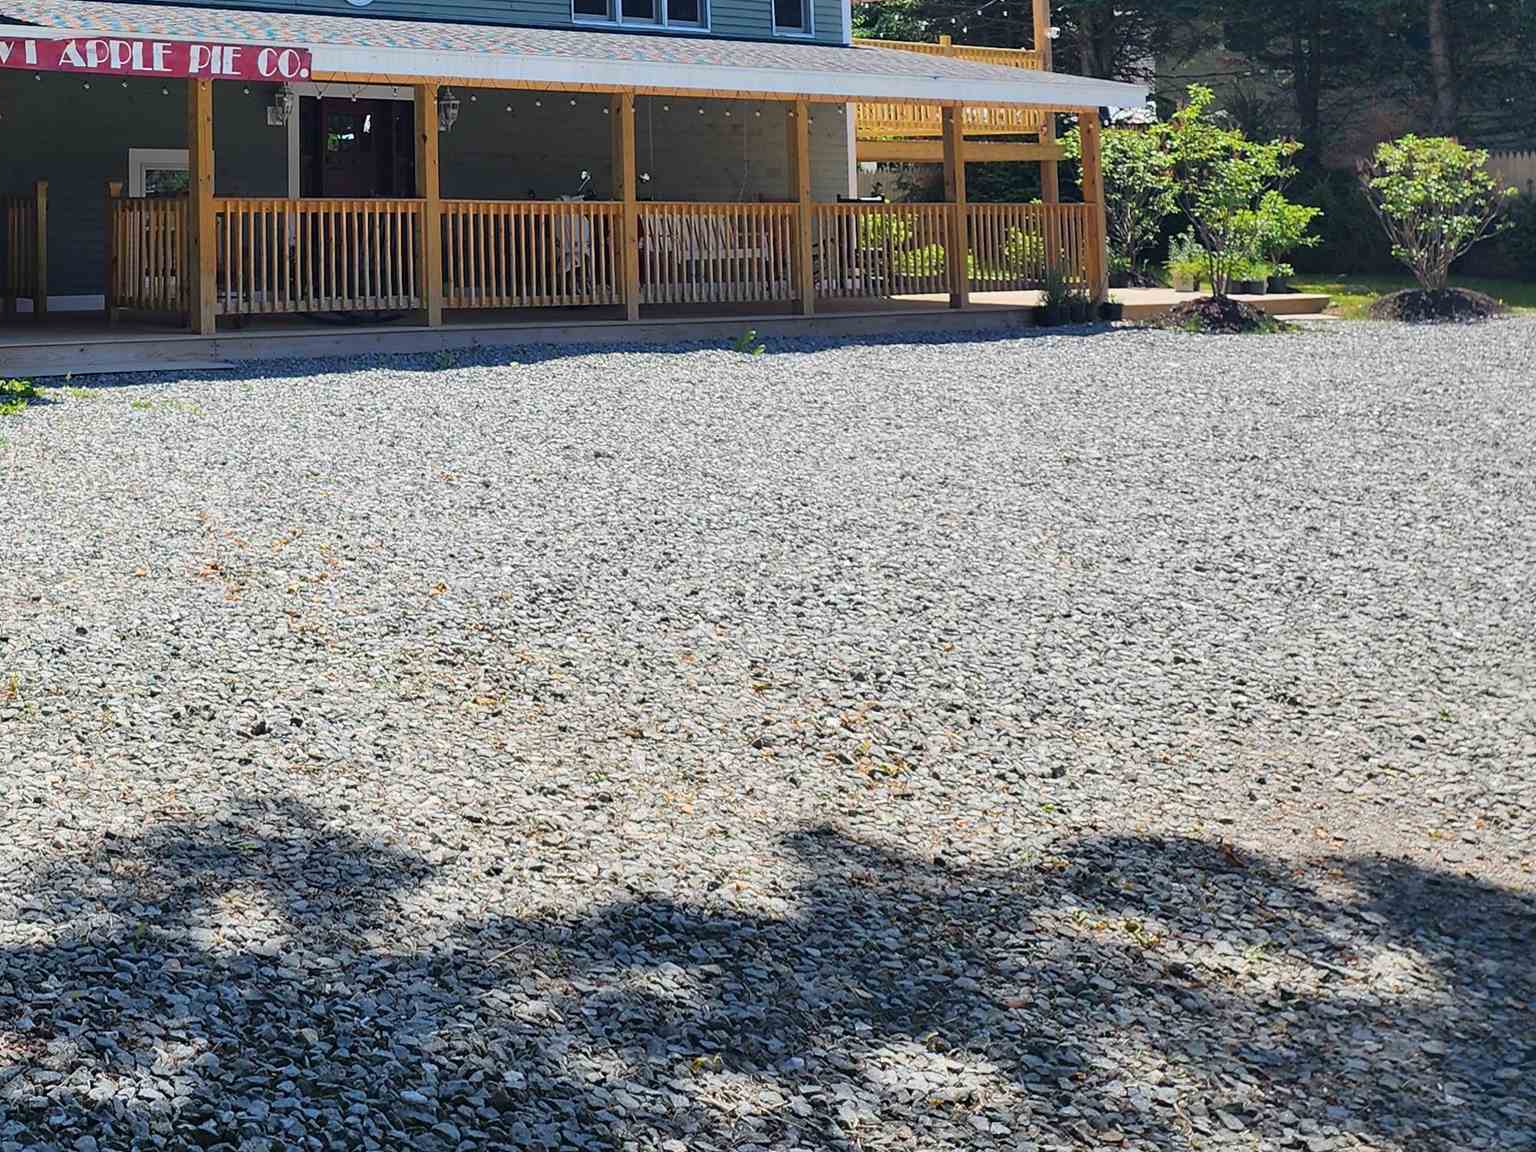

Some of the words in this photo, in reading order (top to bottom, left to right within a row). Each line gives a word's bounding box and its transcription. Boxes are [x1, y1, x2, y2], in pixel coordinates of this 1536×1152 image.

[58, 39, 173, 72] APPLE
[188, 44, 241, 74] PIE
[257, 48, 310, 78] CO.
